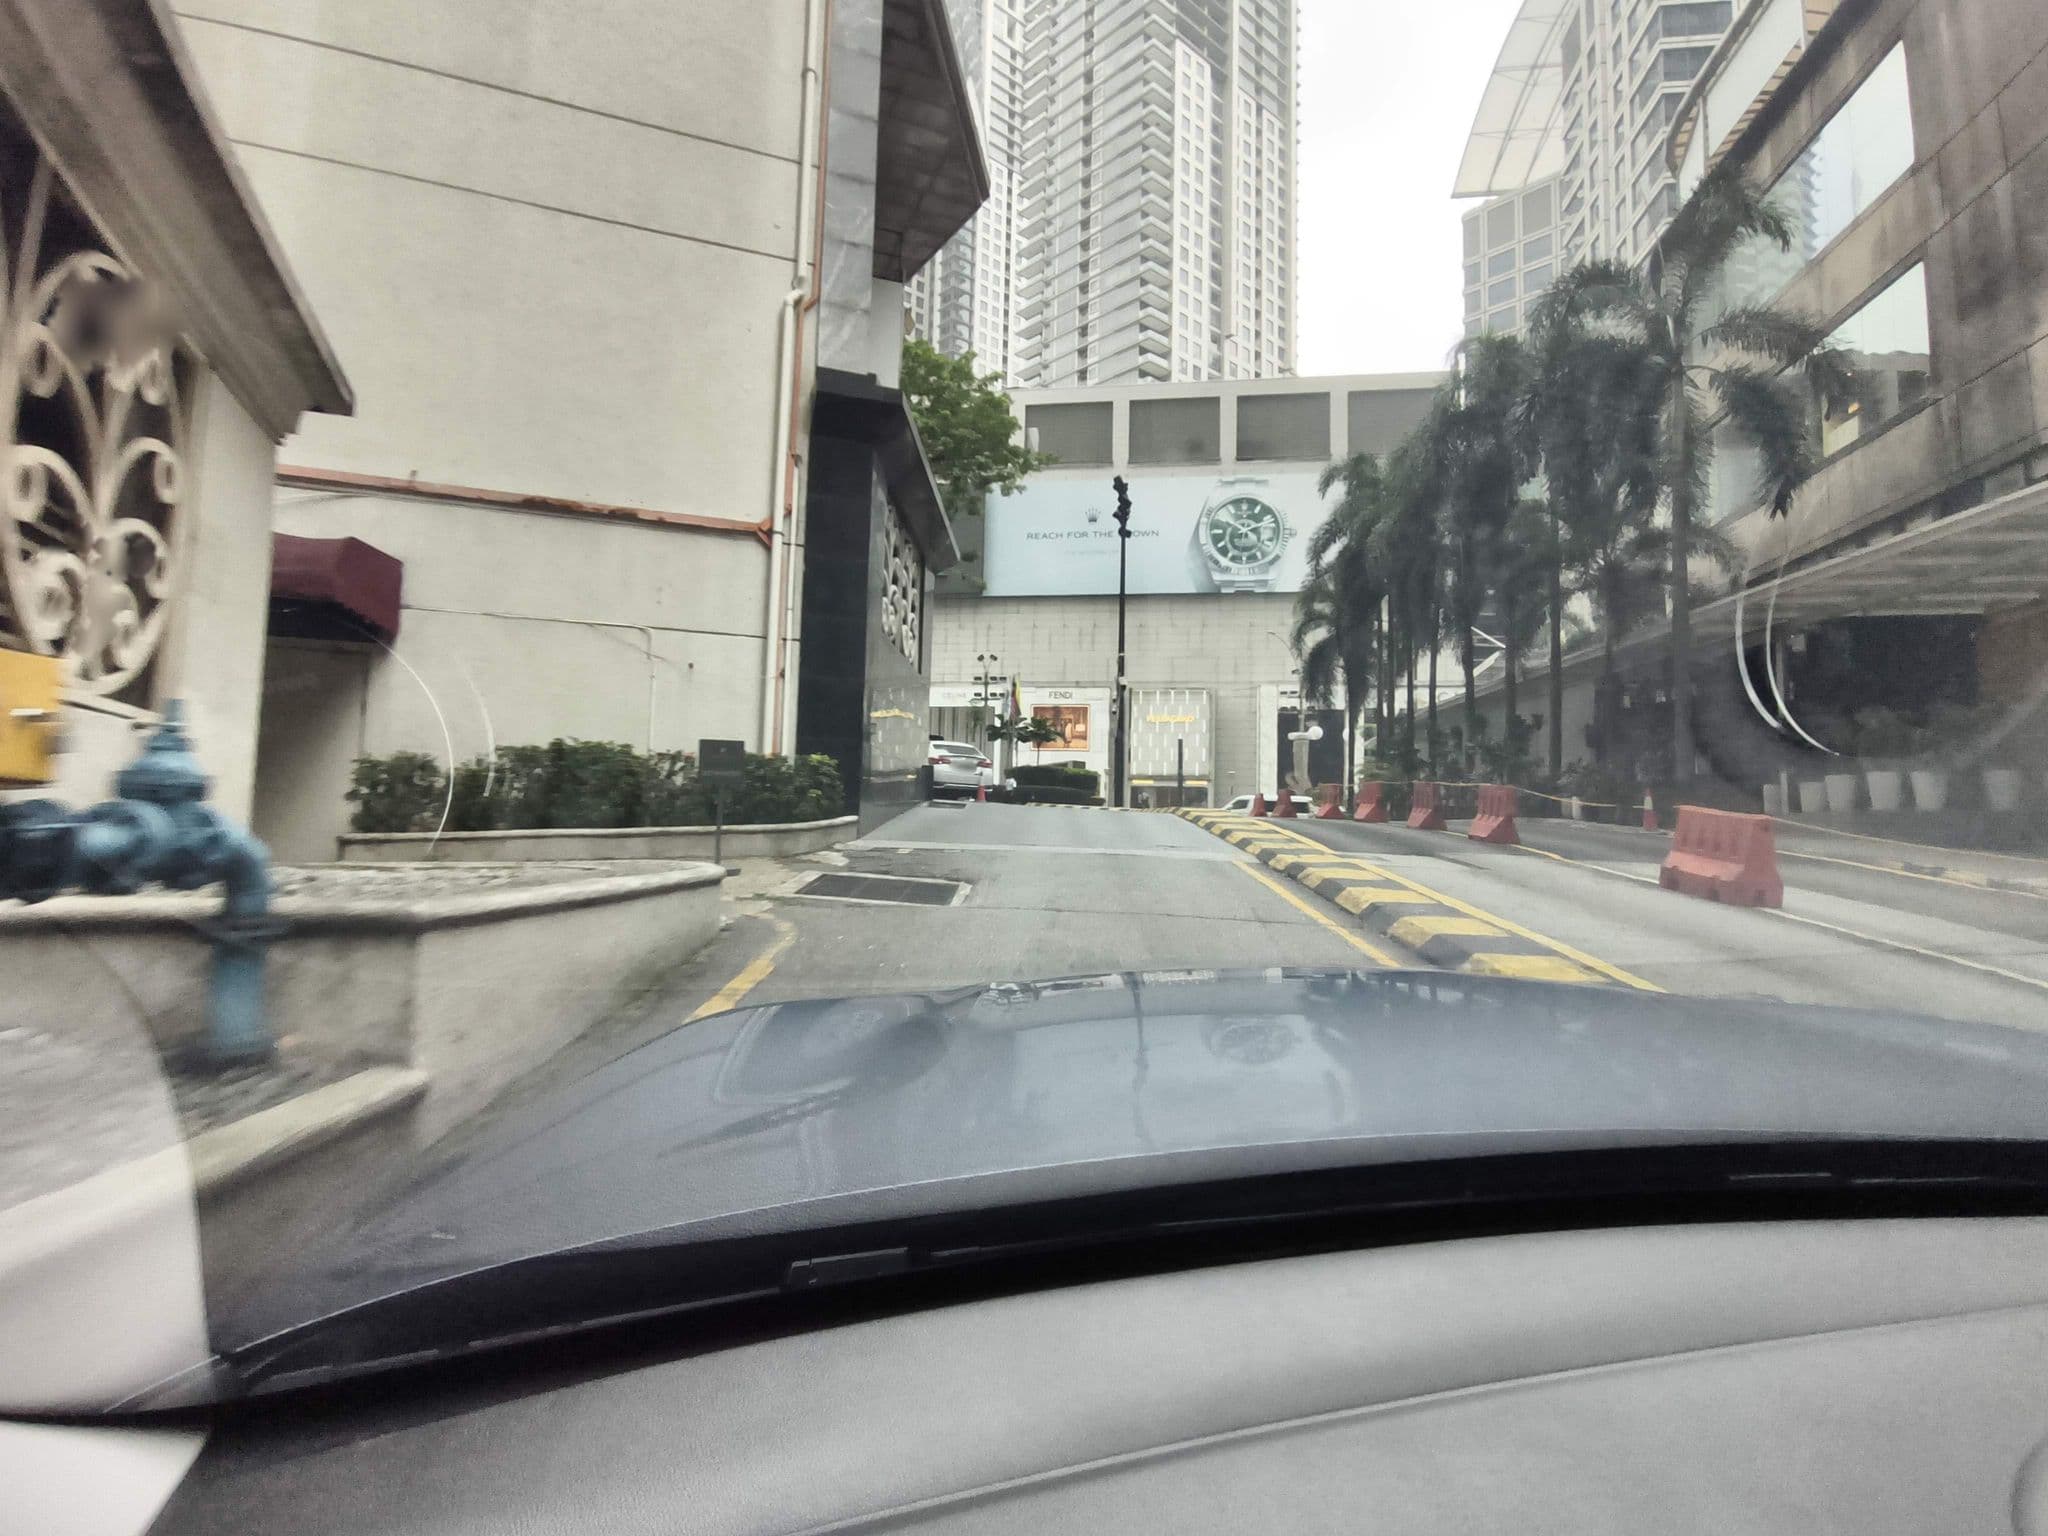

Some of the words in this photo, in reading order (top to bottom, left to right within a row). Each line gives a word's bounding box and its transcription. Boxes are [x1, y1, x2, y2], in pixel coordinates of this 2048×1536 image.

[1026, 531, 1064, 540] REACH
[1066, 530, 1089, 539] FOR
[1093, 529, 1115, 538] THE
[1120, 528, 1160, 537] OWN
[1048, 691, 1073, 700] FENDI
